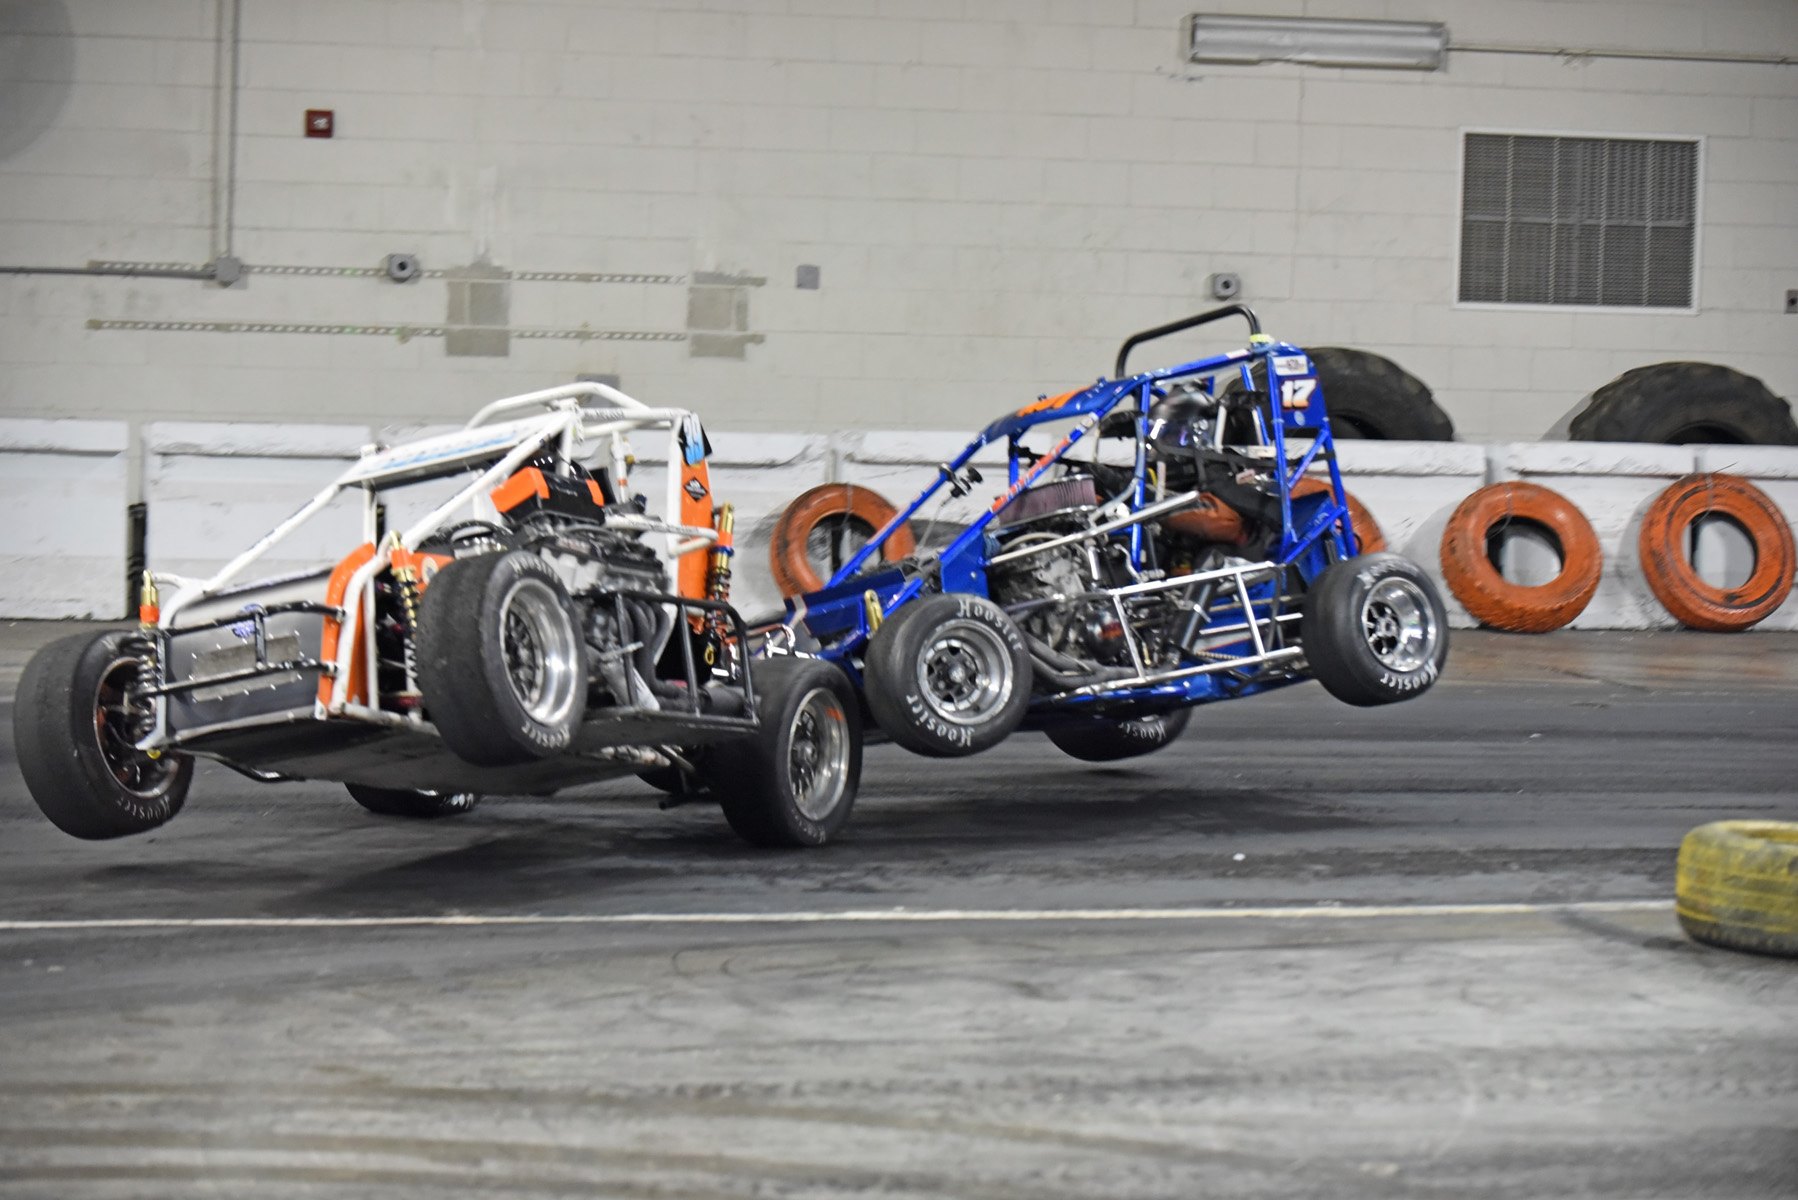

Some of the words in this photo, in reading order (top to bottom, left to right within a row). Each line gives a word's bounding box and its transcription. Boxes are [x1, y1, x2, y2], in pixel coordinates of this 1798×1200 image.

[1280, 377, 1318, 410] 17
[956, 599, 1023, 651] Hoosier
[1380, 658, 1439, 695] Hoosier
[906, 694, 976, 748] Hoosier
